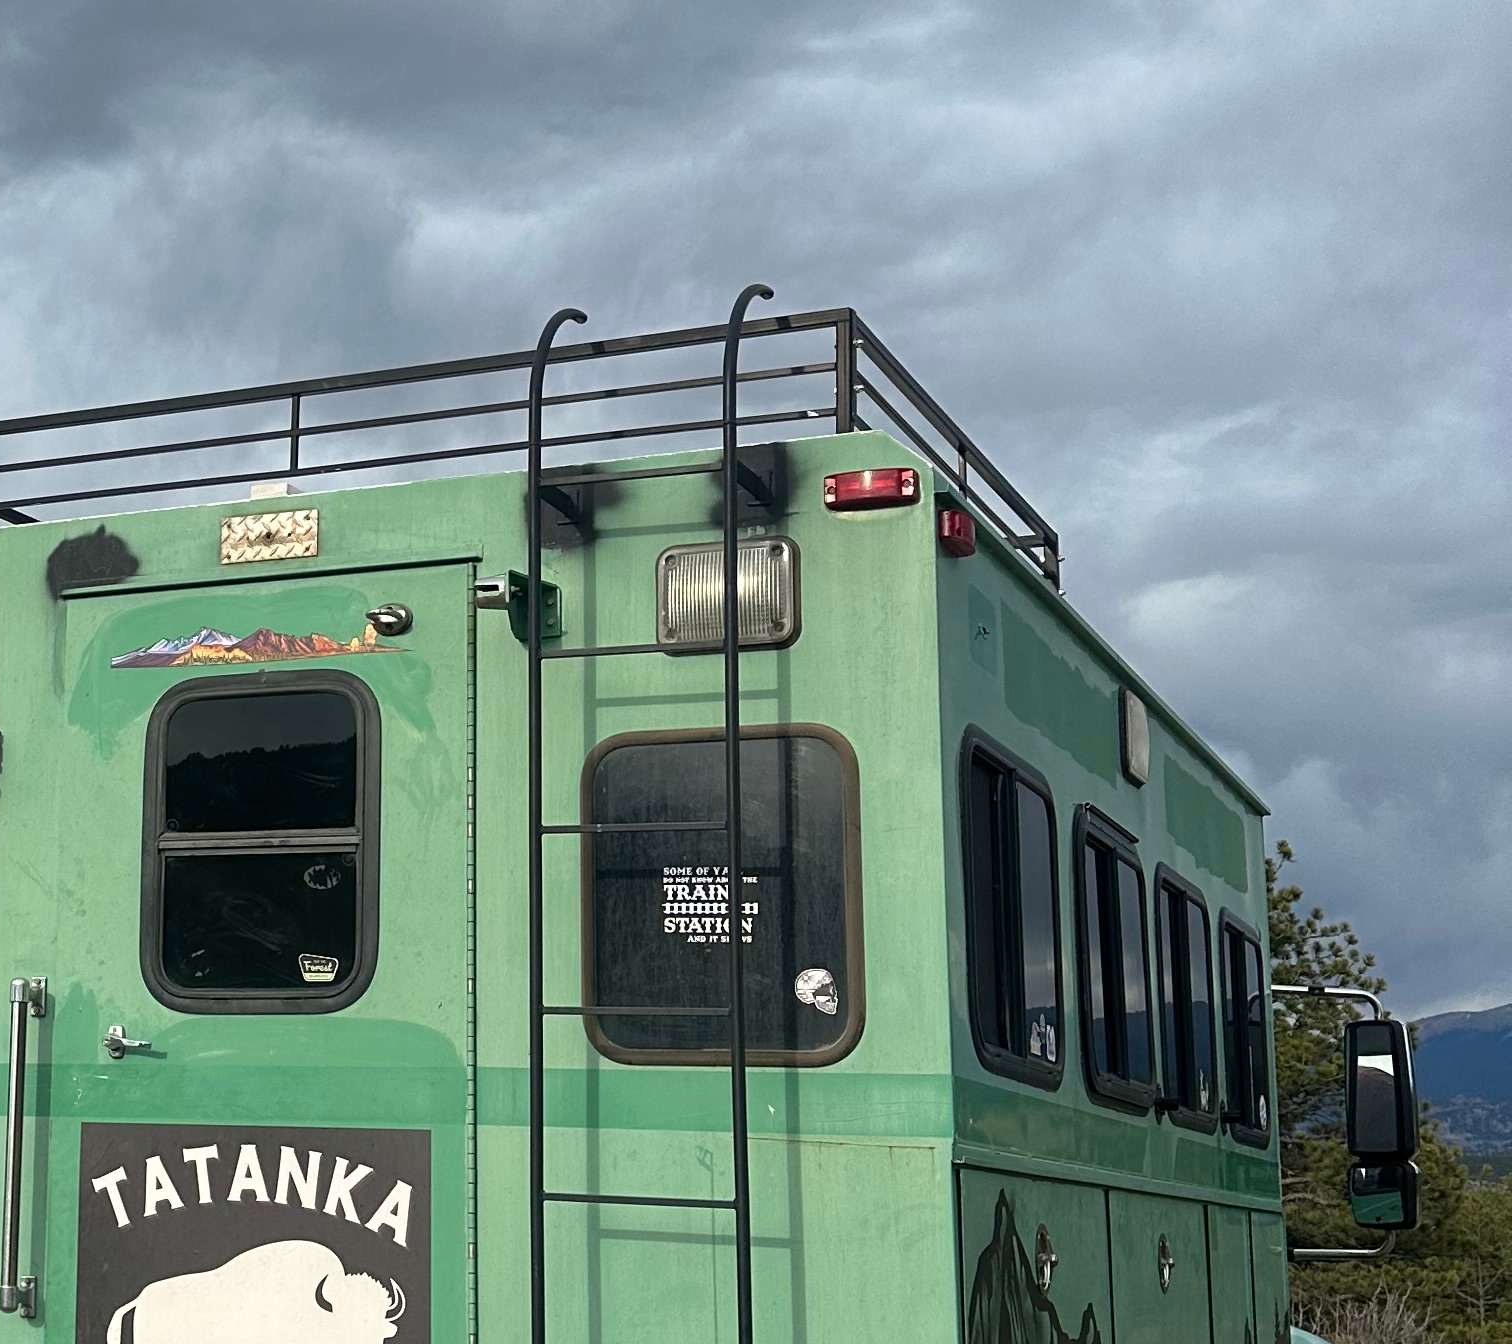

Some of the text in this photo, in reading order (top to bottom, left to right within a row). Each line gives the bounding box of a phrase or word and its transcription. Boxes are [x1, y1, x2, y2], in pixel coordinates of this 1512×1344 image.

[663, 866, 693, 876] SOME
[696, 866, 711, 876] OF
[663, 884, 729, 901] TRAIN
[687, 935, 707, 943] AND
[709, 935, 719, 943] IT
[302, 960, 334, 972] Forest
[90, 1143, 414, 1248] TATANKA
